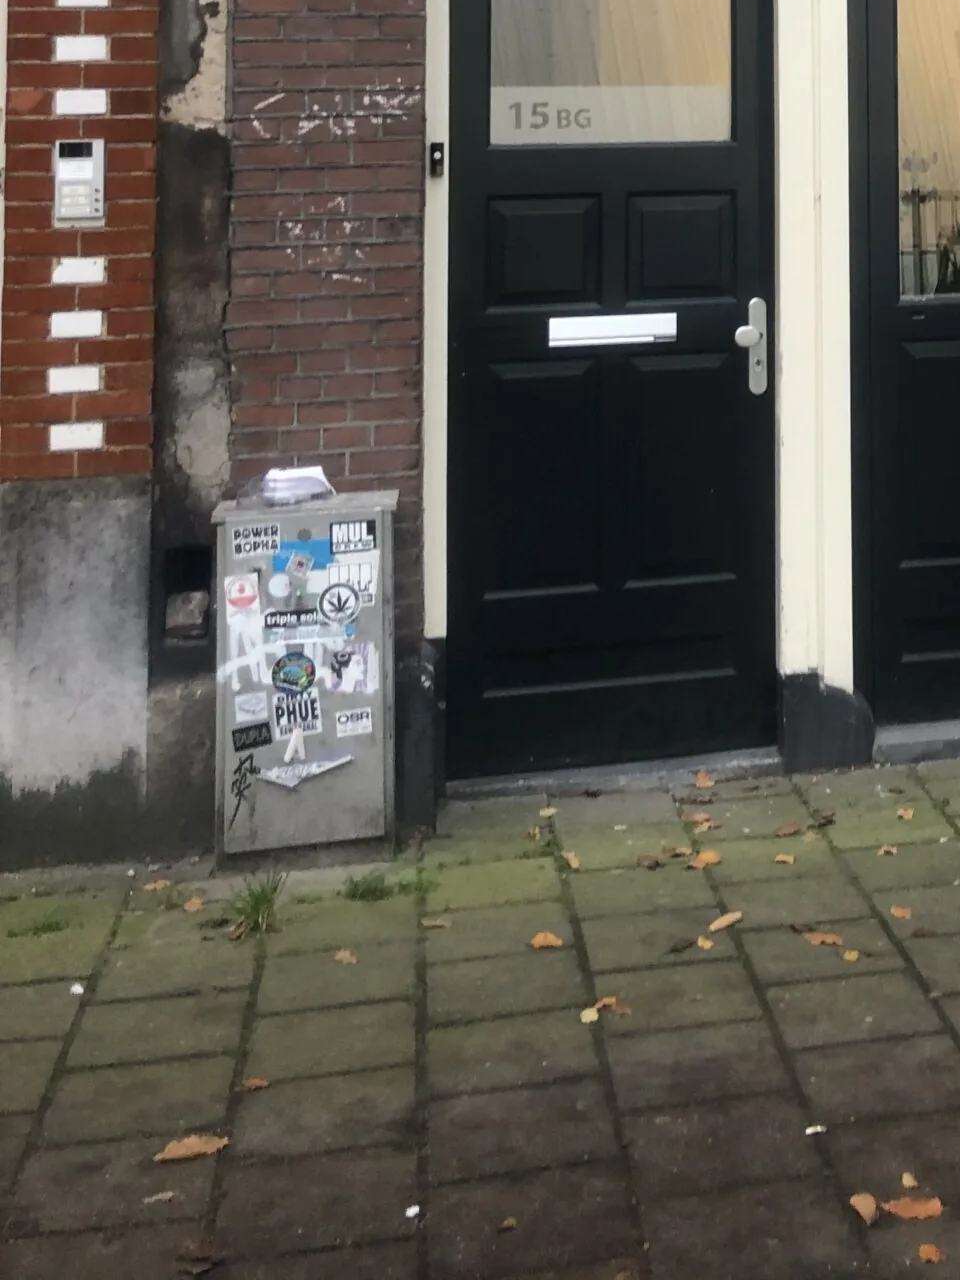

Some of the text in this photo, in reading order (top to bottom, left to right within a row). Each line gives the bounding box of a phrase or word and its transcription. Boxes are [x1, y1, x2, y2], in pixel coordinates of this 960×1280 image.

[508, 101, 592, 130] 15 BG
[233, 524, 279, 540] POWER
[266, 612, 298, 626] triple
[275, 698, 319, 727] PHUE
